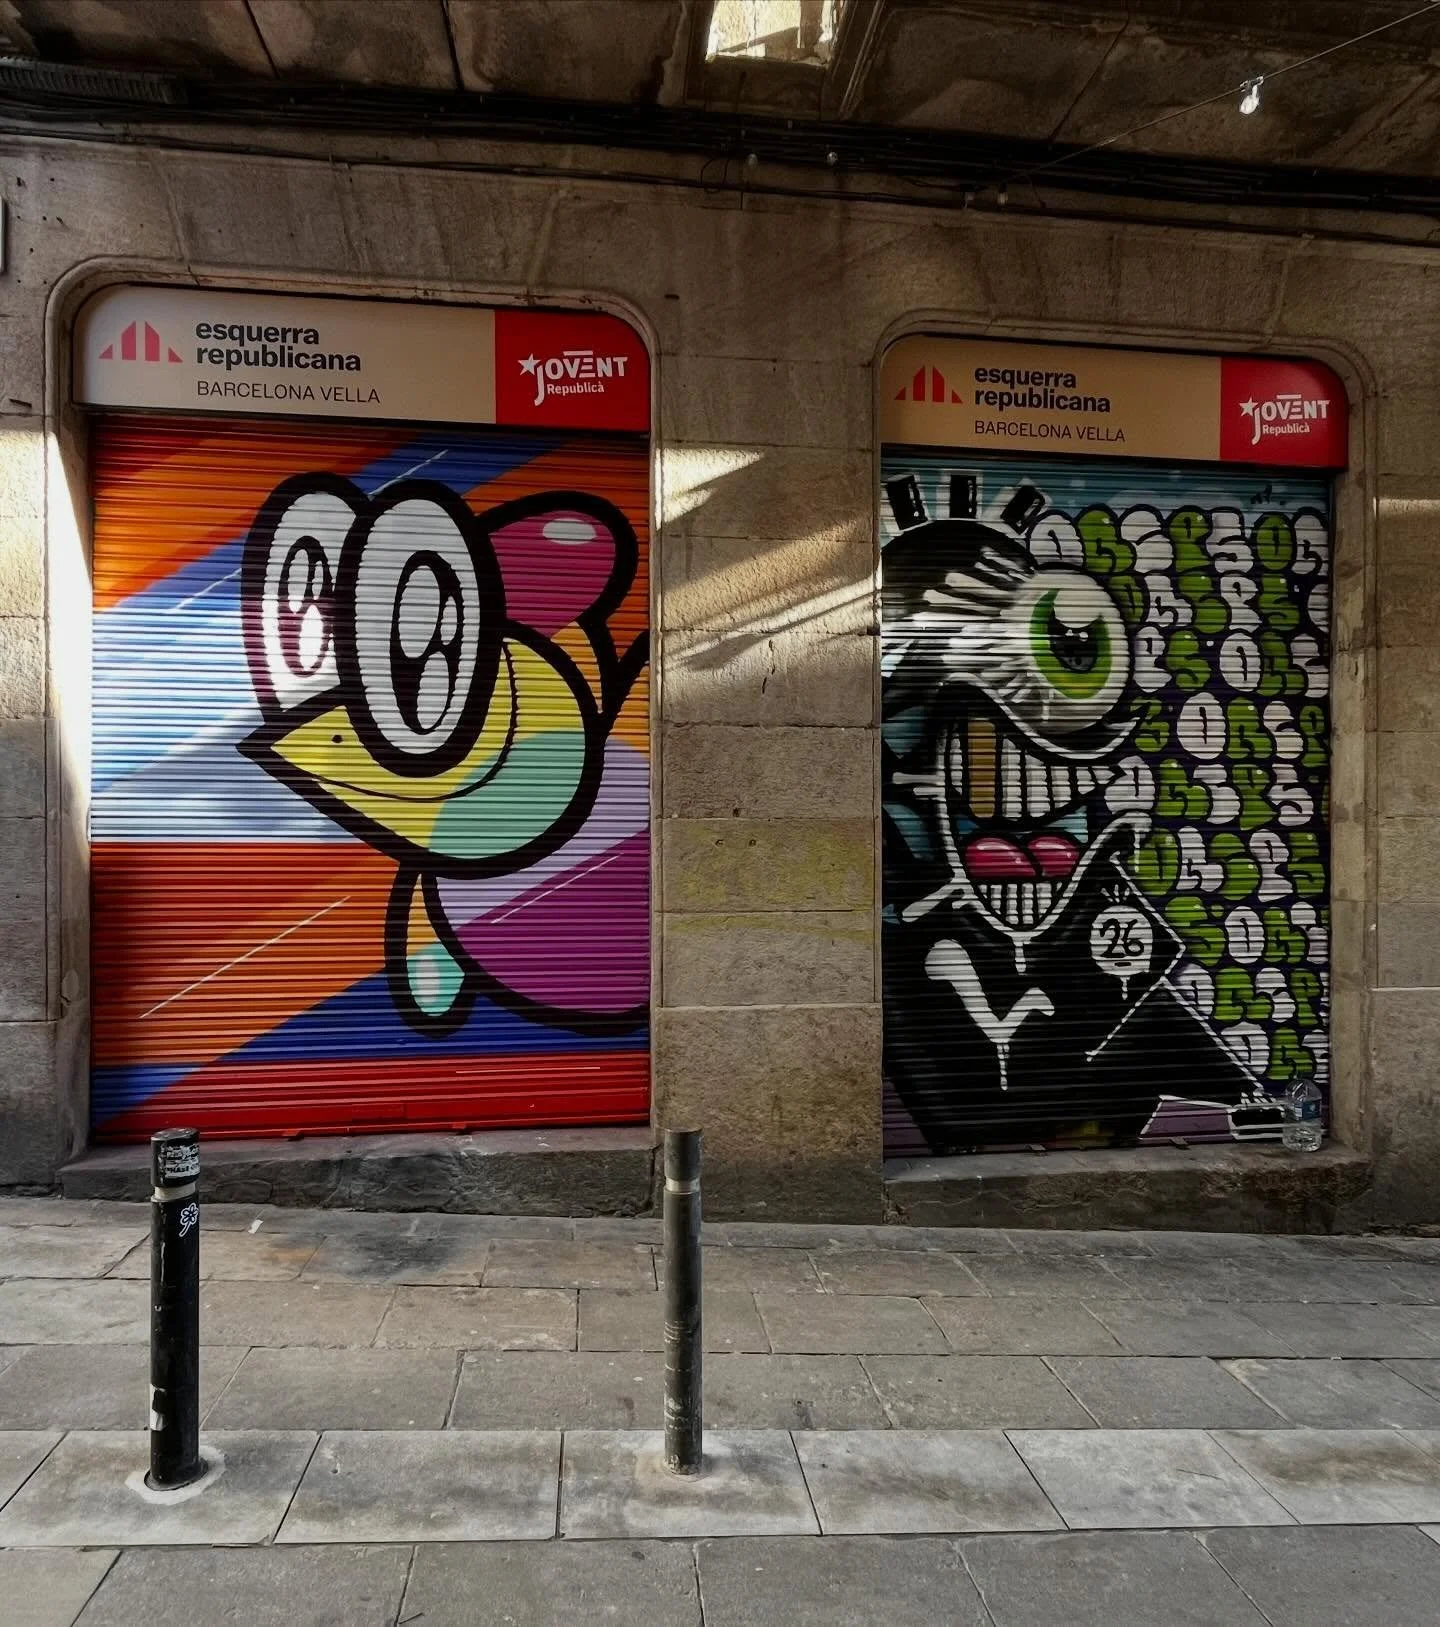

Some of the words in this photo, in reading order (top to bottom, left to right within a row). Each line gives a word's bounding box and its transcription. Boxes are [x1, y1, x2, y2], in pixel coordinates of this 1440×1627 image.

[195, 321, 319, 347] esquerra
[196, 345, 361, 371] republicana
[547, 381, 605, 396] Republicà
[974, 367, 1077, 389] esquerra
[197, 380, 315, 401] BARCELONA
[320, 386, 381, 403] VELLA
[974, 388, 1111, 413] republicana
[974, 420, 1072, 439] BARCELONA
[1076, 426, 1126, 442] VELLA
[1262, 422, 1311, 436] Republicà
[1098, 918, 1145, 959] 26
